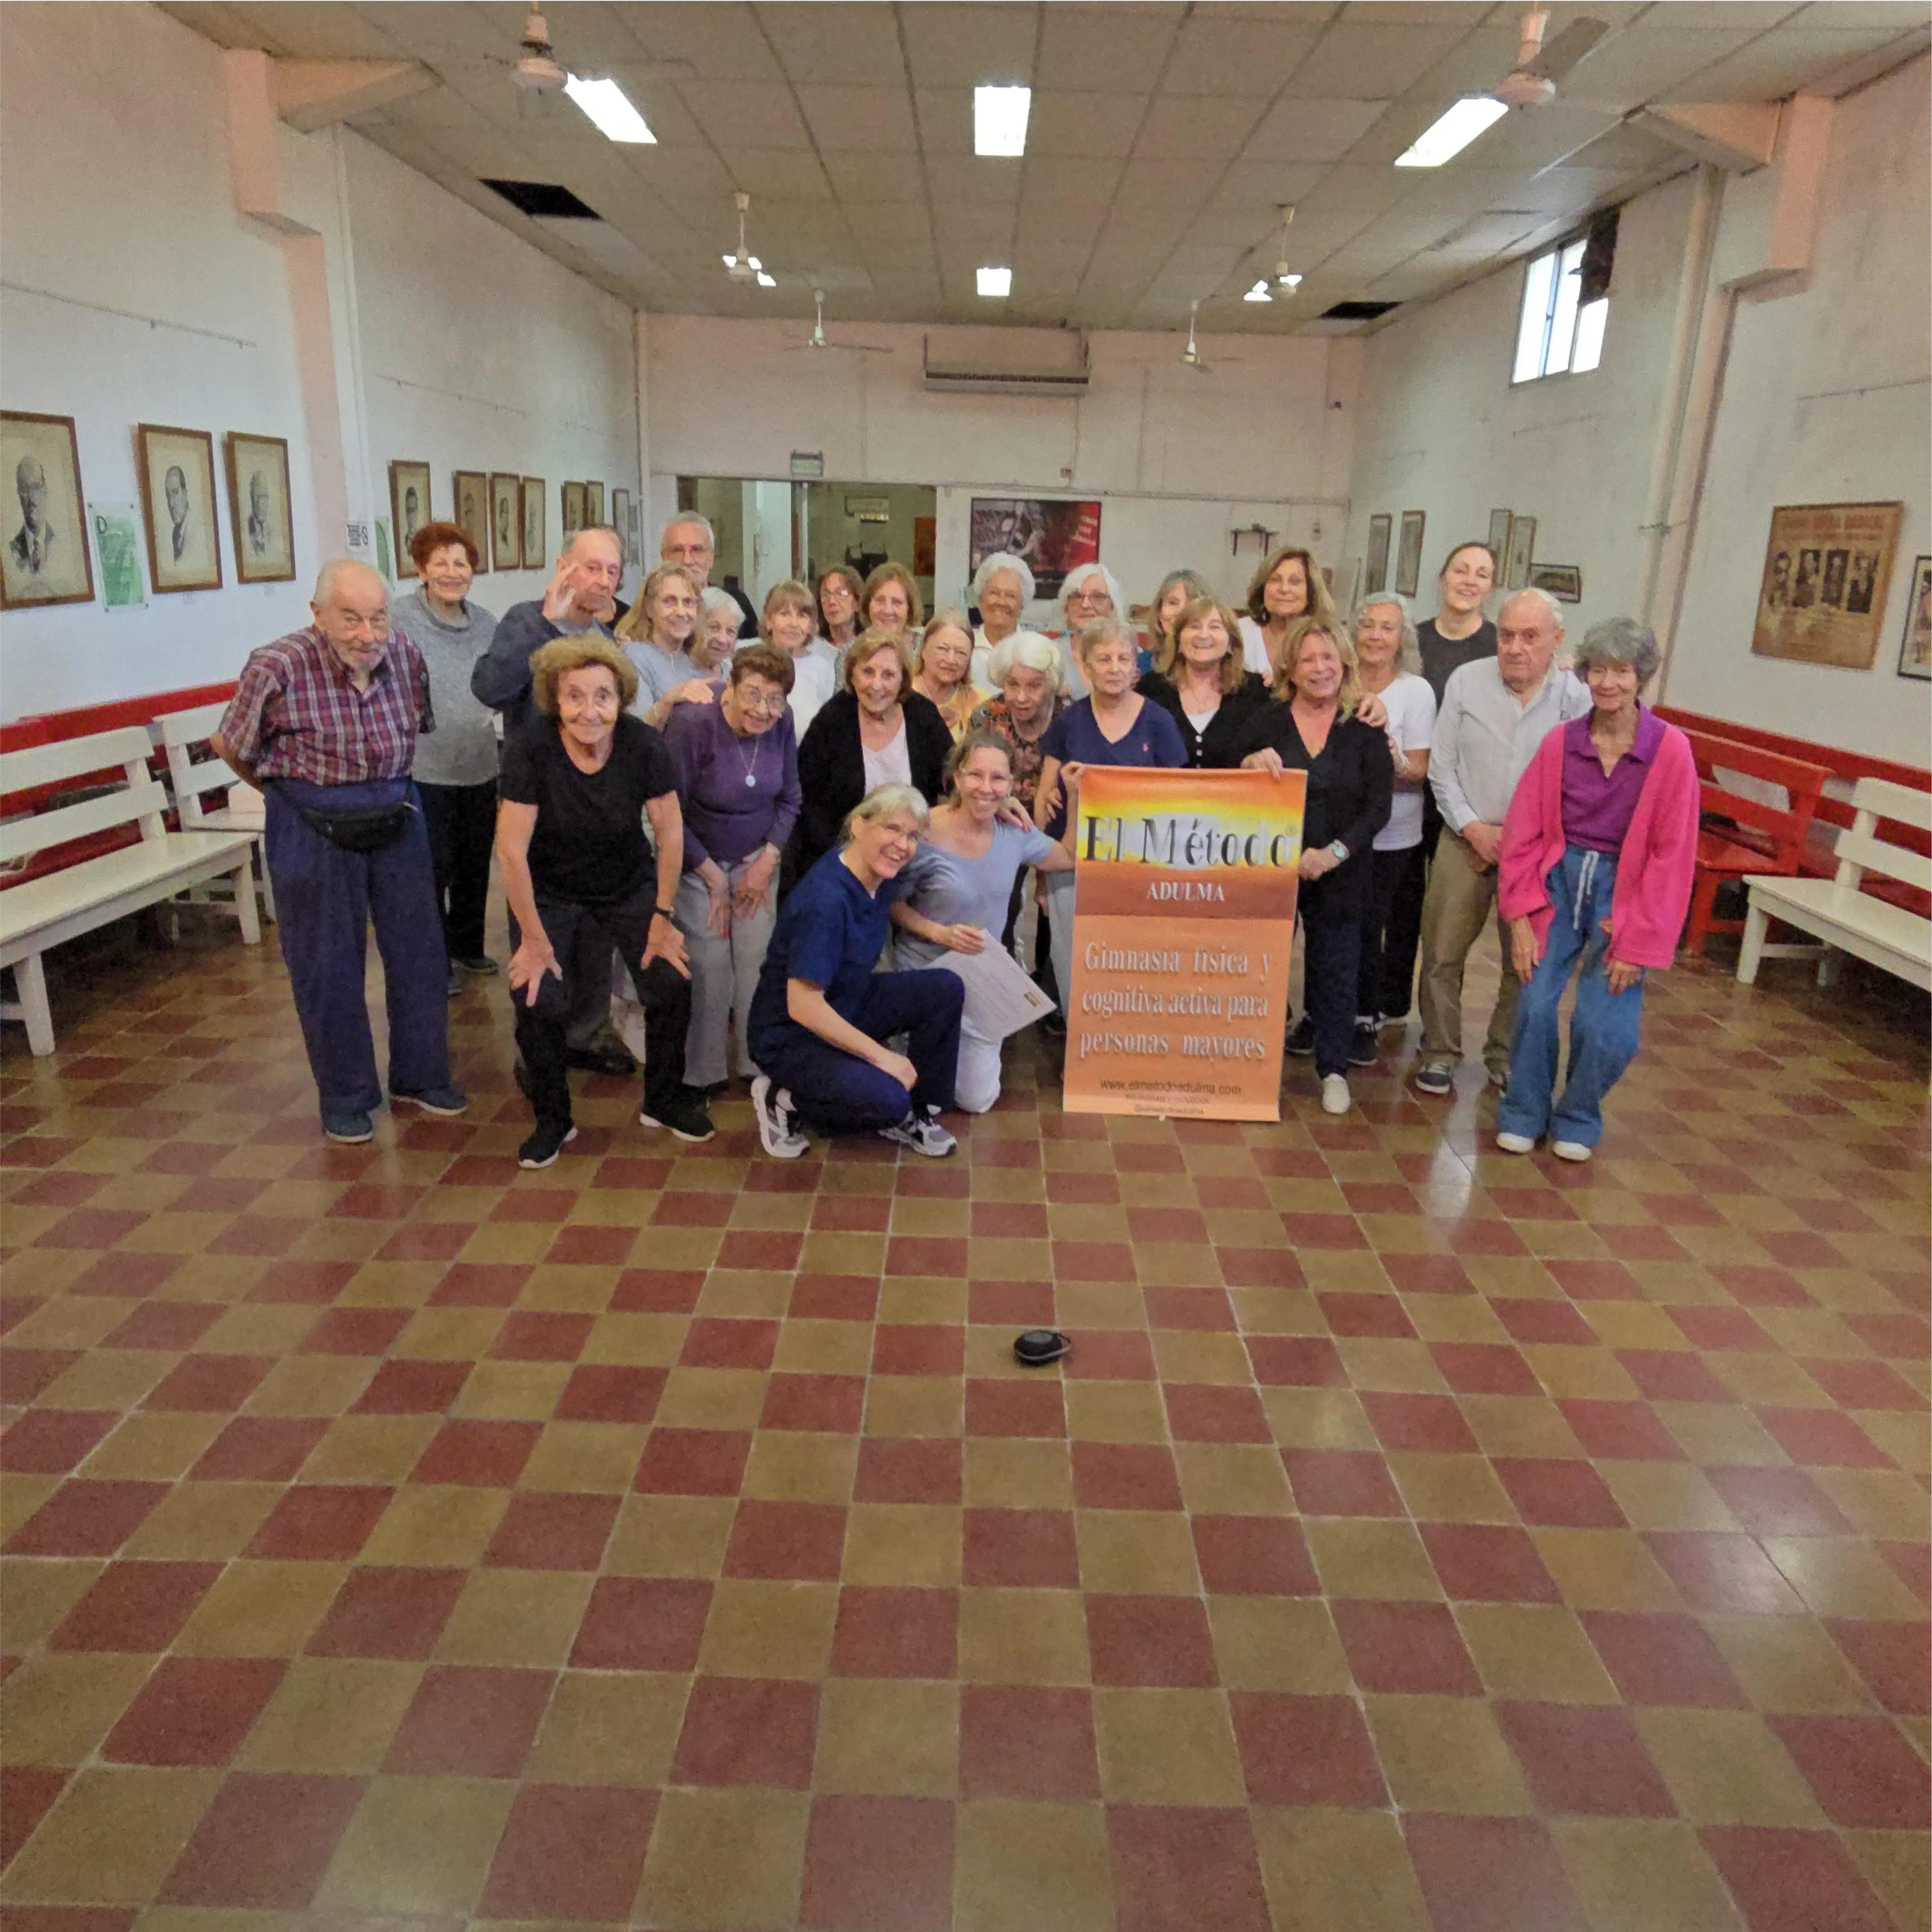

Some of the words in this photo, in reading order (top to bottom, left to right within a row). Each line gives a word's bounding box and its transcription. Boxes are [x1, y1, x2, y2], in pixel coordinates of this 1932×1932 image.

[1085, 815, 1125, 863] El
[1146, 881, 1226, 902] ADULMA
[1085, 940, 1180, 972] Gimnasia
[1082, 984, 1163, 1019] cognitiva
[1167, 985, 1222, 1016] activa
[1227, 993, 1268, 1022] para
[1079, 1032, 1169, 1058] personas
[1183, 1035, 1265, 1063] mayores
